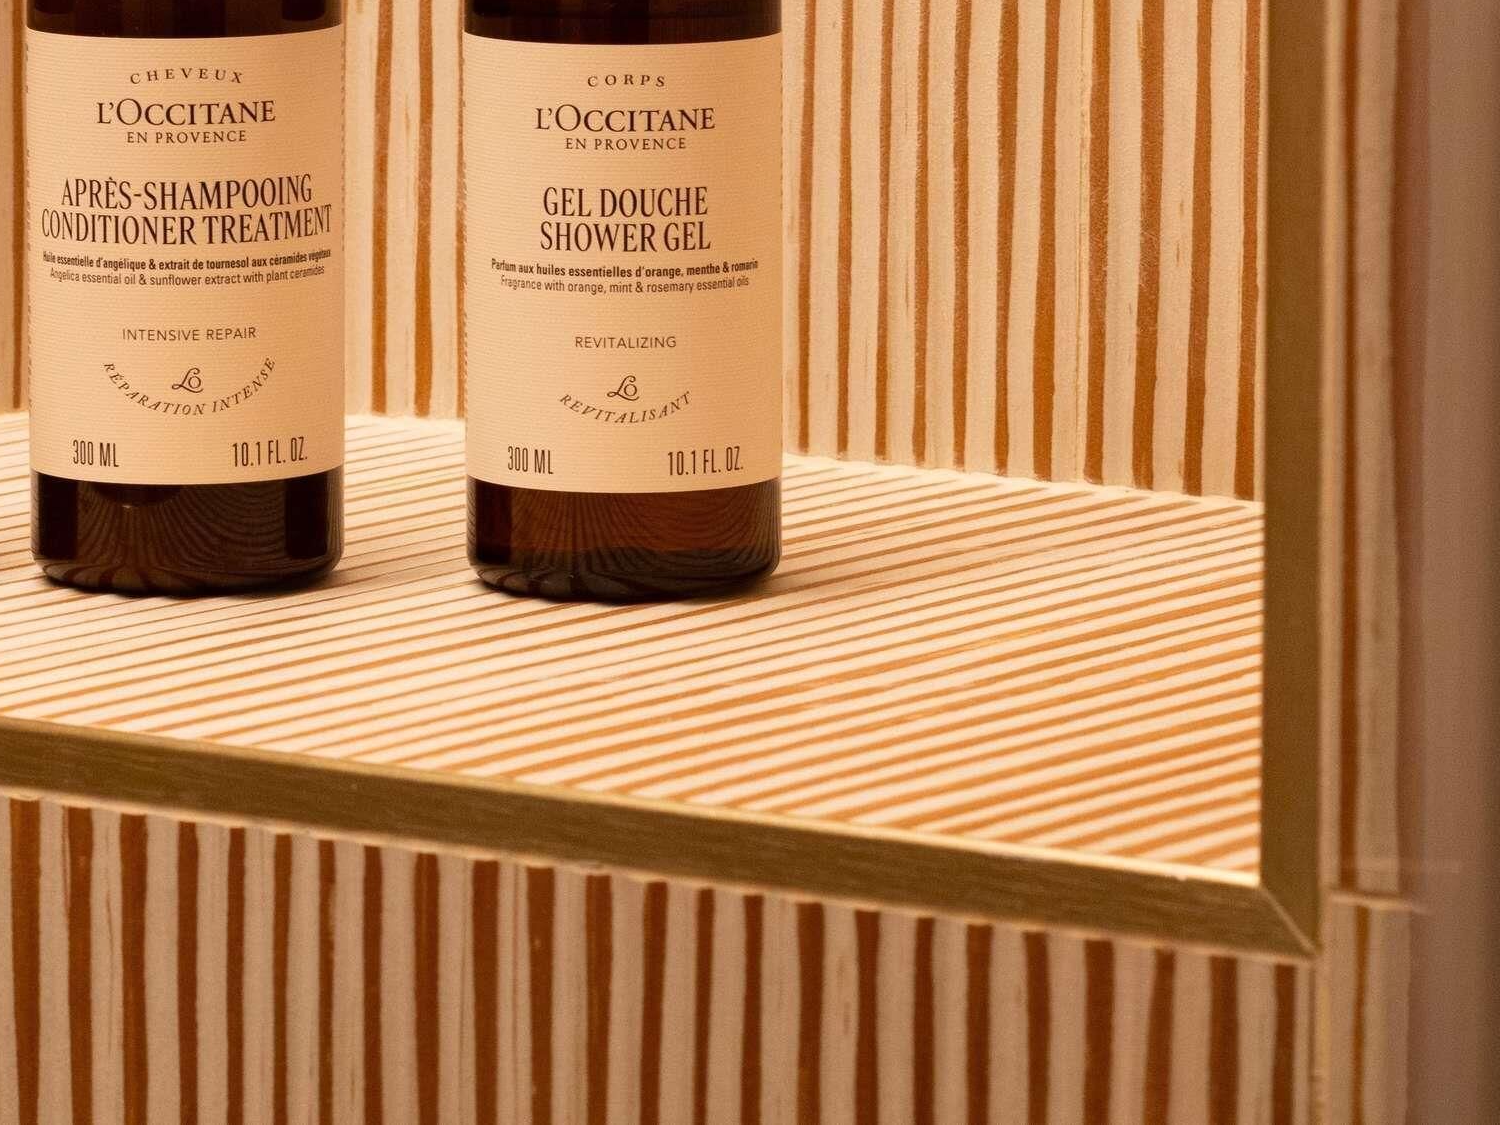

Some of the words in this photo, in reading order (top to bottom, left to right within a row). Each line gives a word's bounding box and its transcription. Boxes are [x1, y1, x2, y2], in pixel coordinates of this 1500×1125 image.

[130, 68, 243, 85] CHEVEUX
[587, 74, 666, 87] CORPS
[96, 98, 276, 126] L'OCCITANE
[536, 104, 716, 132] L'OCCITANE
[127, 131, 149, 143] EN
[156, 130, 247, 144] PROVENCE
[565, 138, 586, 150] EN
[595, 137, 686, 150] PROVENCE
[61, 173, 312, 211] APRÈS-SHAMPOOING
[543, 186, 592, 216] GEL
[601, 186, 708, 218] DOUCHE
[42, 208, 195, 246] CONDITIONER
[202, 204, 332, 245] TREATMENT
[540, 222, 657, 253] SHOWER
[665, 221, 711, 251] GEL
[50, 267, 80, 282] Angelica
[82, 273, 121, 285] essential
[124, 274, 136, 285] oil
[139, 274, 147, 285] &
[150, 274, 204, 285] sunflower
[205, 274, 241, 285] extract
[242, 271, 264, 283] with
[266, 270, 288, 283] plant
[290, 265, 324, 278] ceramides
[57, 254, 93, 268] essentielle
[96, 256, 146, 271] d'angélique
[149, 258, 156, 270] &
[159, 259, 190, 270] extrait
[192, 259, 204, 270] de
[206, 257, 249, 269] tournesol
[251, 258, 267, 267] aux
[269, 251, 307, 266] céramides
[492, 258, 516, 272] Parfum
[519, 265, 533, 274] aux
[537, 264, 565, 276] huiles
[569, 266, 631, 277] essentielles
[687, 263, 720, 275] menthe
[723, 261, 730, 273] &
[731, 258, 758, 272] romarin
[501, 275, 541, 290] Fragrance
[544, 280, 564, 291] with
[568, 283, 606, 295] orange,
[609, 282, 632, 293] mint
[635, 282, 643, 293] &
[647, 282, 693, 293] rosemary
[697, 277, 734, 290] essential
[737, 275, 749, 287] oils
[122, 328, 200, 341] INTENSIVE
[206, 327, 256, 340] REPAIR
[575, 336, 676, 348] REVITALIZING
[104, 363, 207, 416] RÉPARATION
[212, 357, 276, 413] INTENSE
[560, 391, 692, 423] REVITALISANT
[72, 439, 94, 465] 300
[99, 442, 119, 467] ML
[232, 442, 261, 467] 10.1
[268, 440, 286, 465] FL.
[290, 436, 308, 462] OZ.
[508, 446, 528, 472] 300
[534, 449, 553, 474] ML
[668, 450, 696, 475] 10.1
[703, 449, 721, 473] FL.
[726, 446, 743, 471] OZ.
